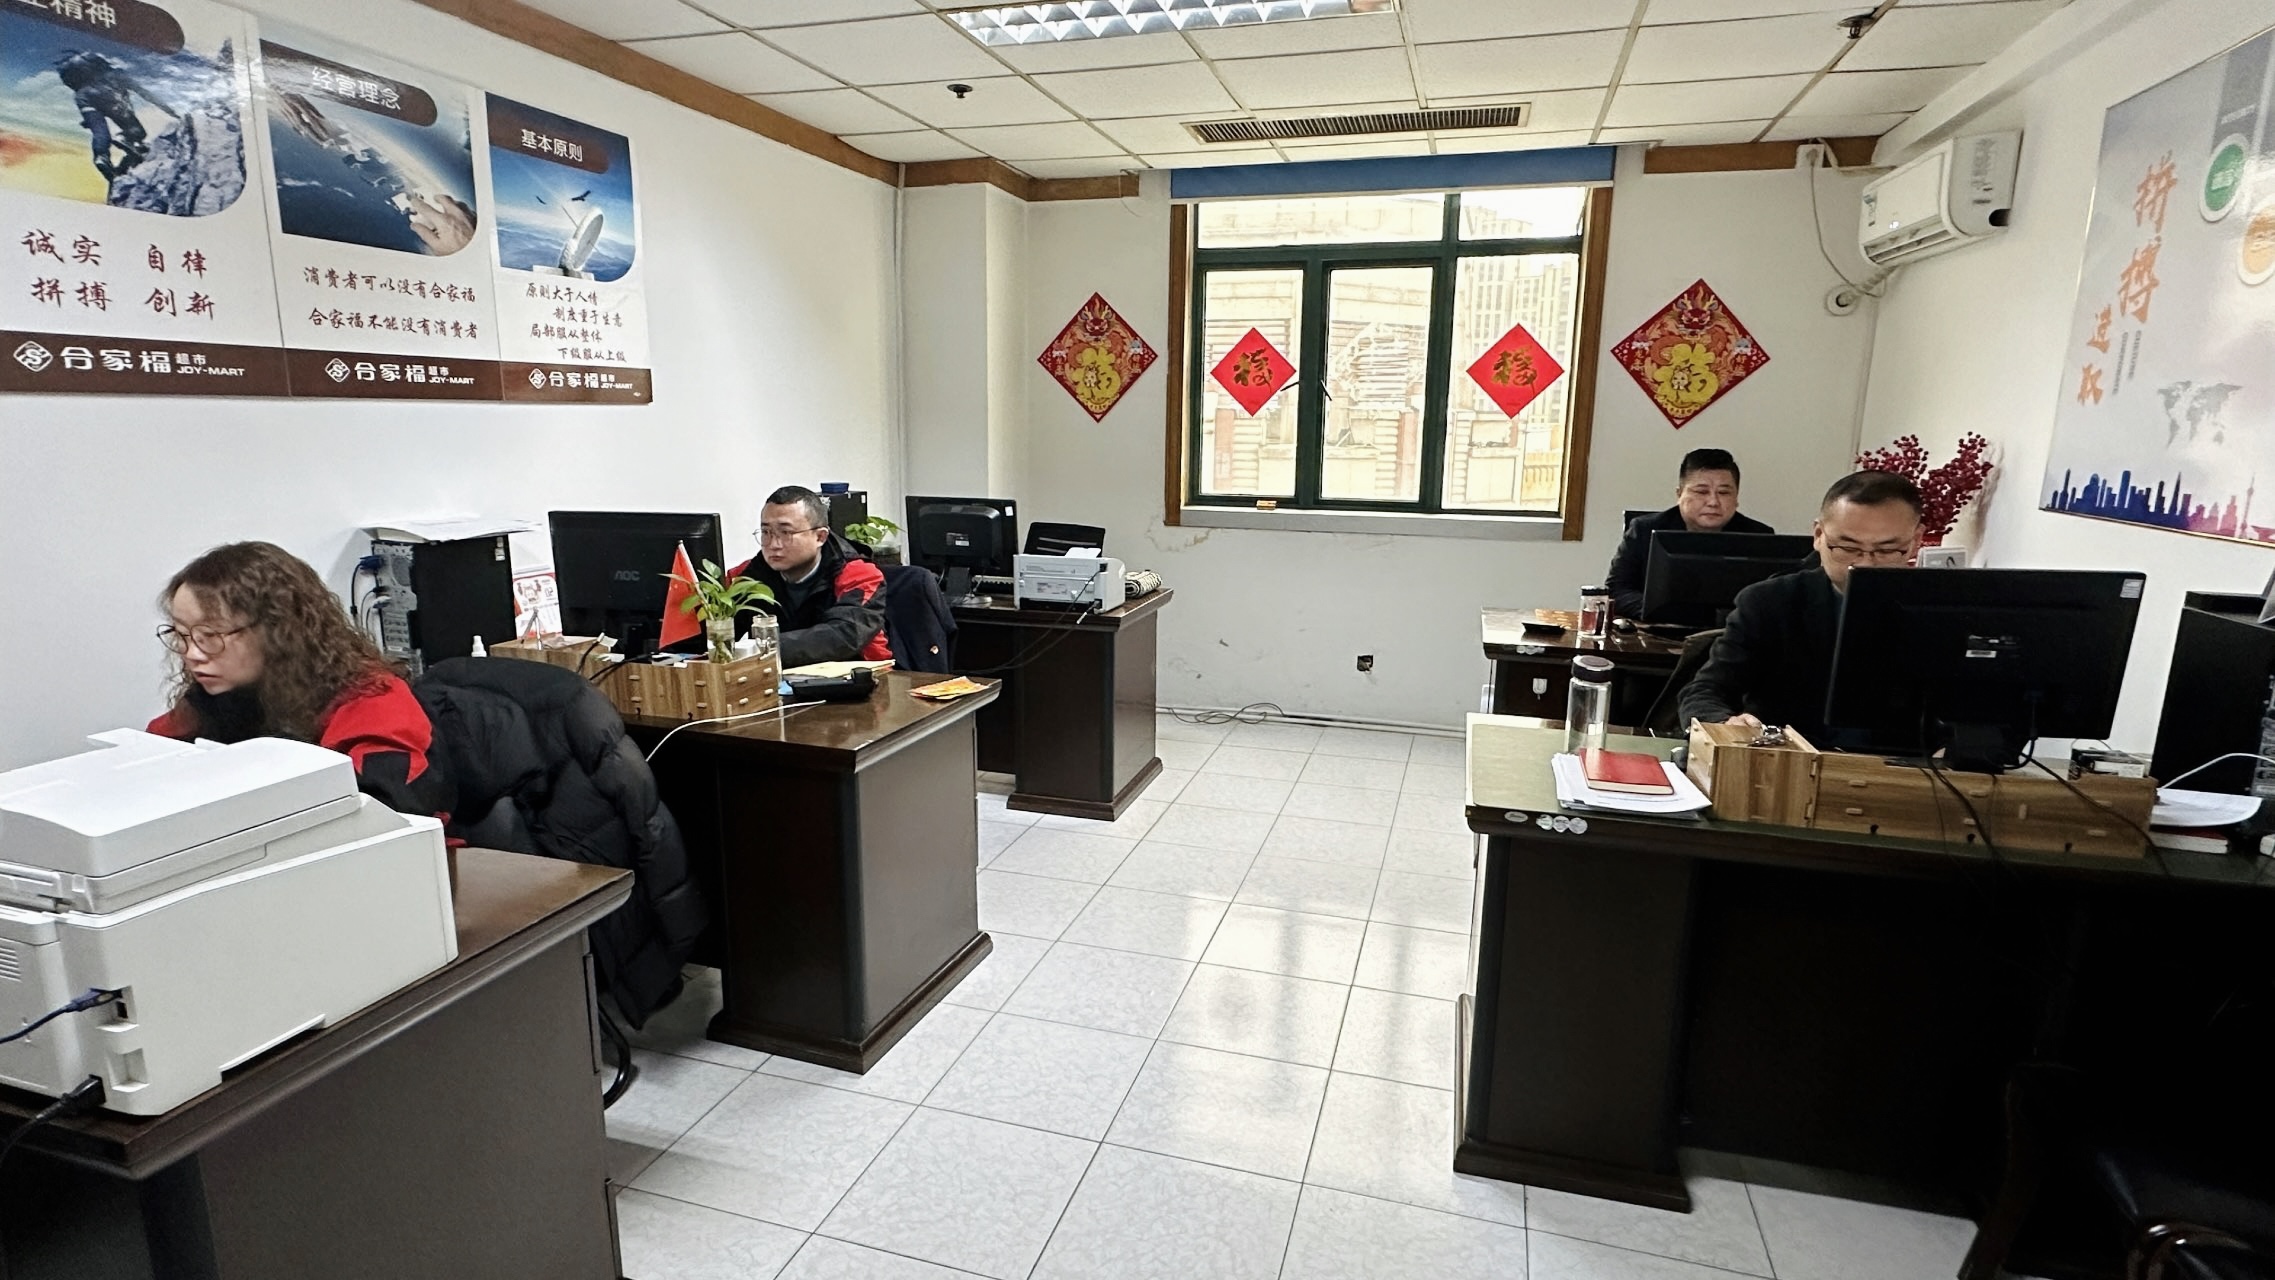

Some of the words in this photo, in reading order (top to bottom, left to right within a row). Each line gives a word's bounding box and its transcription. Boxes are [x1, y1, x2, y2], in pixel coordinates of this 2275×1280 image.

[18, 0, 117, 29] 精神
[311, 66, 400, 110] 经营理念
[520, 128, 583, 162] 基本原则
[21, 229, 102, 266] 诚实
[148, 244, 208, 279] 自律
[31, 277, 113, 311] 拼搏
[144, 288, 215, 320] 创新
[60, 346, 172, 374] 合家福
[176, 366, 245, 376] JOY-MART
[354, 361, 426, 383] 合家福
[429, 376, 475, 385] JOY-MART
[548, 371, 599, 388] 合家福
[614, 570, 640, 580] AOC
